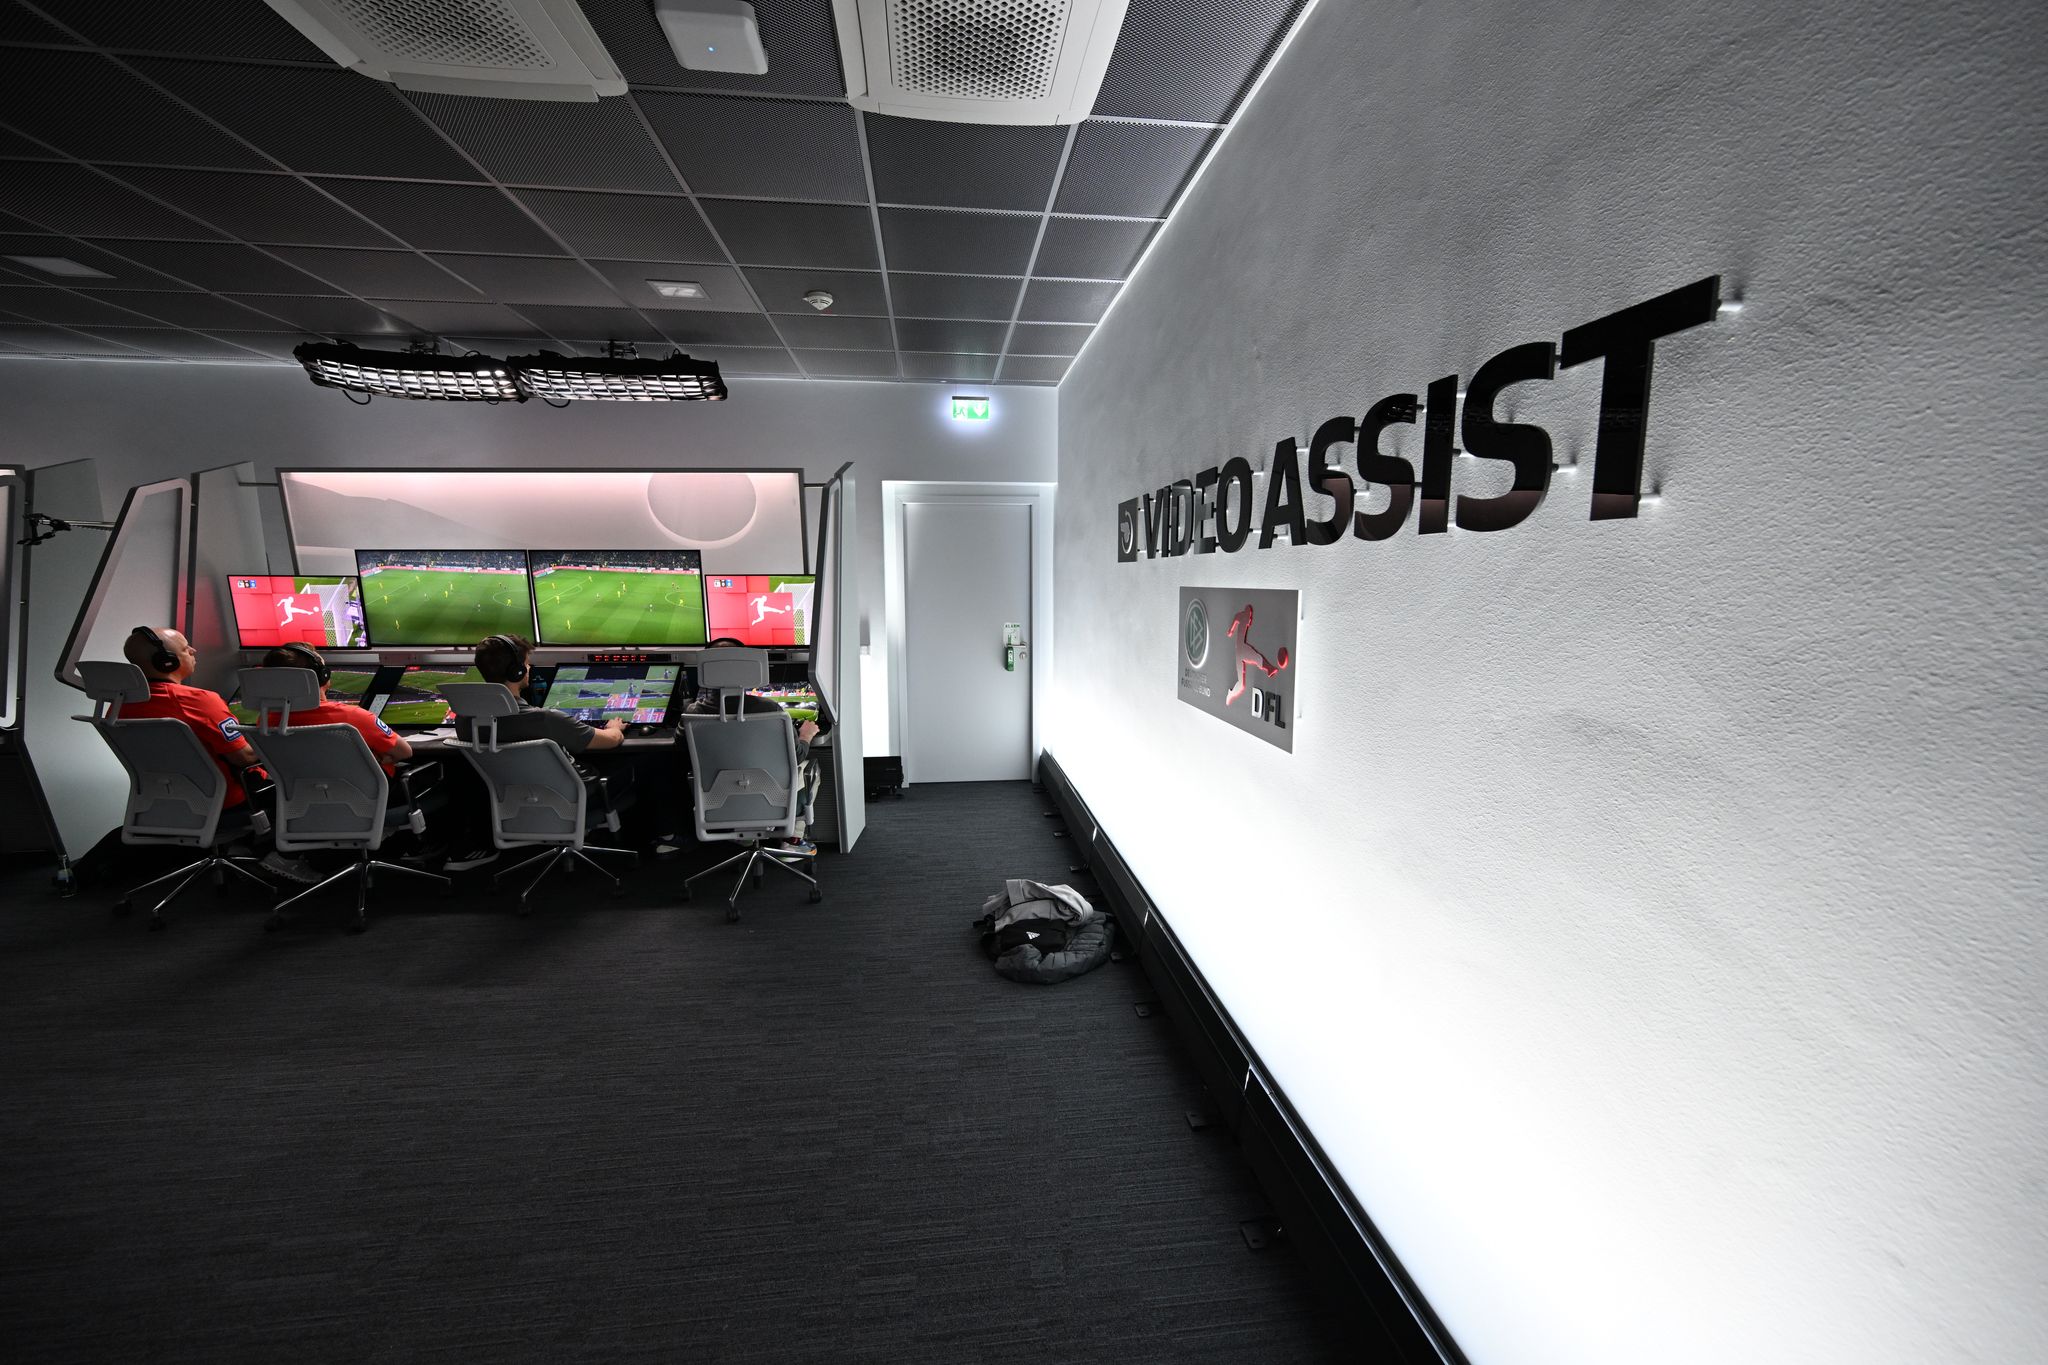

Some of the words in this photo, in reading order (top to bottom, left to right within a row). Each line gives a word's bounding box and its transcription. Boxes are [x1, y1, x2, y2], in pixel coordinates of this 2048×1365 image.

[1143, 457, 1253, 559] VIDEO
[1258, 275, 1721, 549] ASSIST
[1252, 687, 1286, 729] DFL
